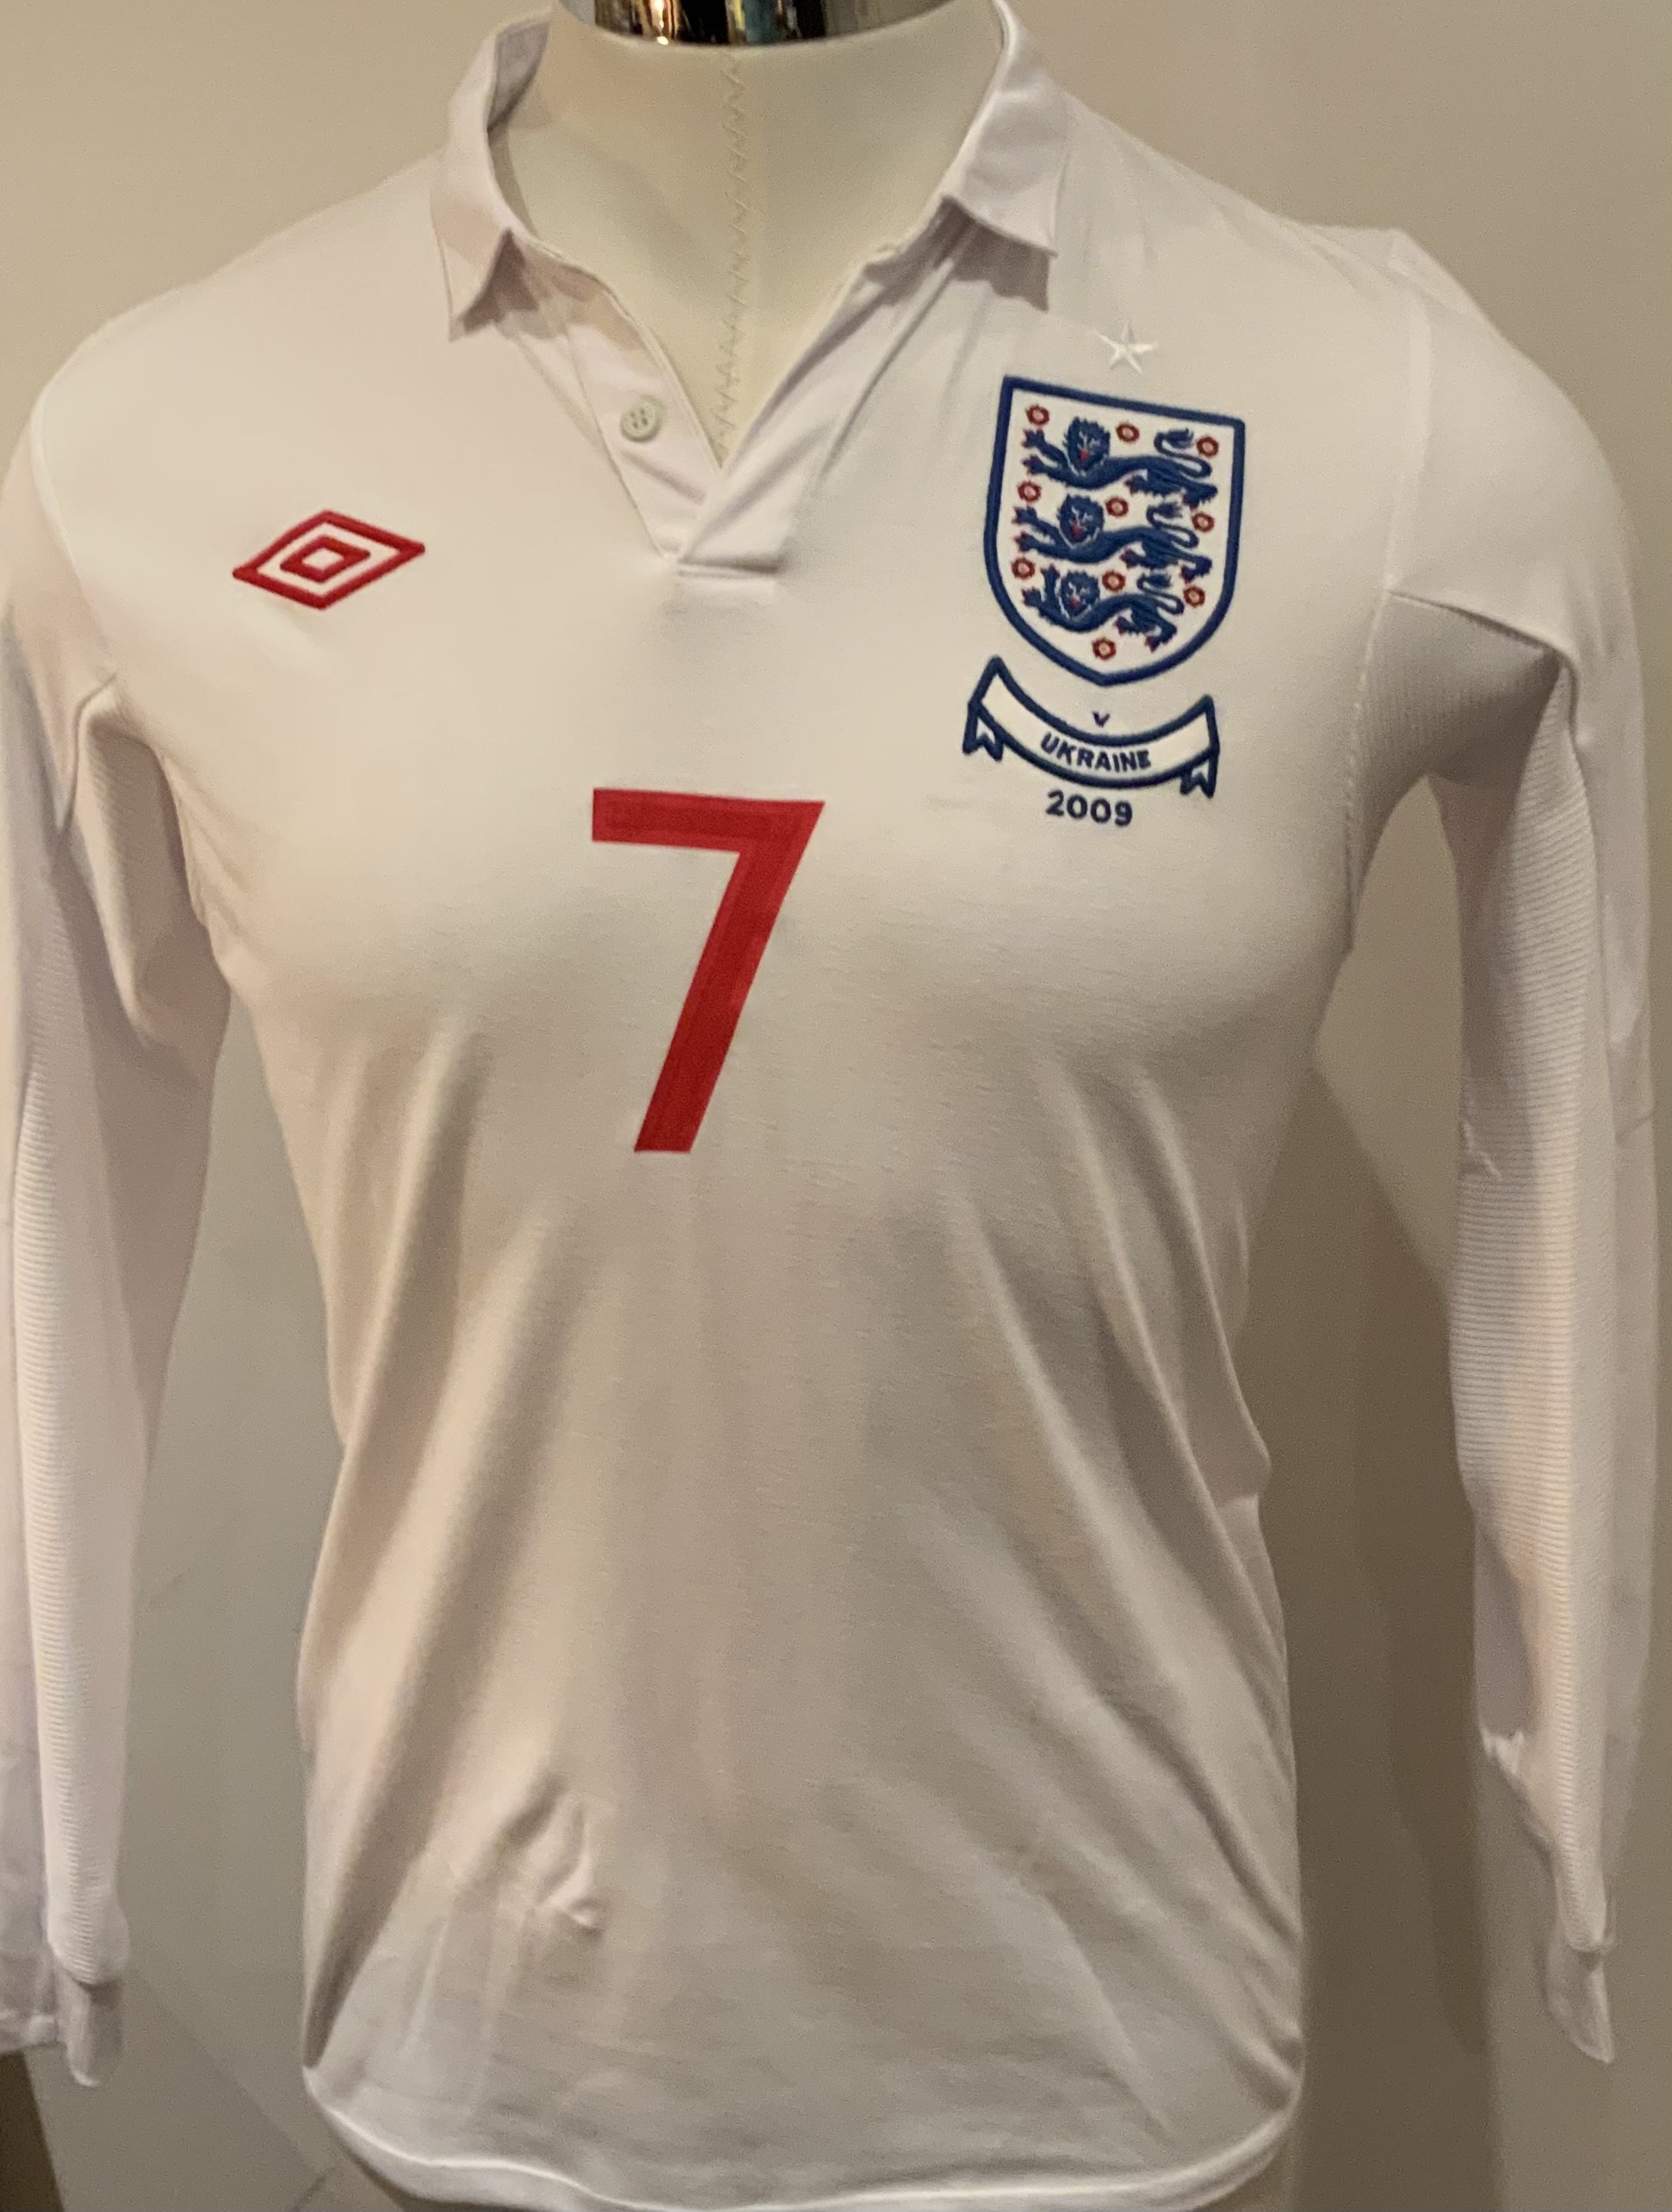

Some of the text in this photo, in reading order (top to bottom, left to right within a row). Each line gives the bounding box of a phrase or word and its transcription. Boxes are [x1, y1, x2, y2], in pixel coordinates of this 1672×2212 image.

[1040, 733, 1151, 772] UKRAINE
[1045, 790, 1133, 827] 2009
[591, 787, 826, 1153] 7
